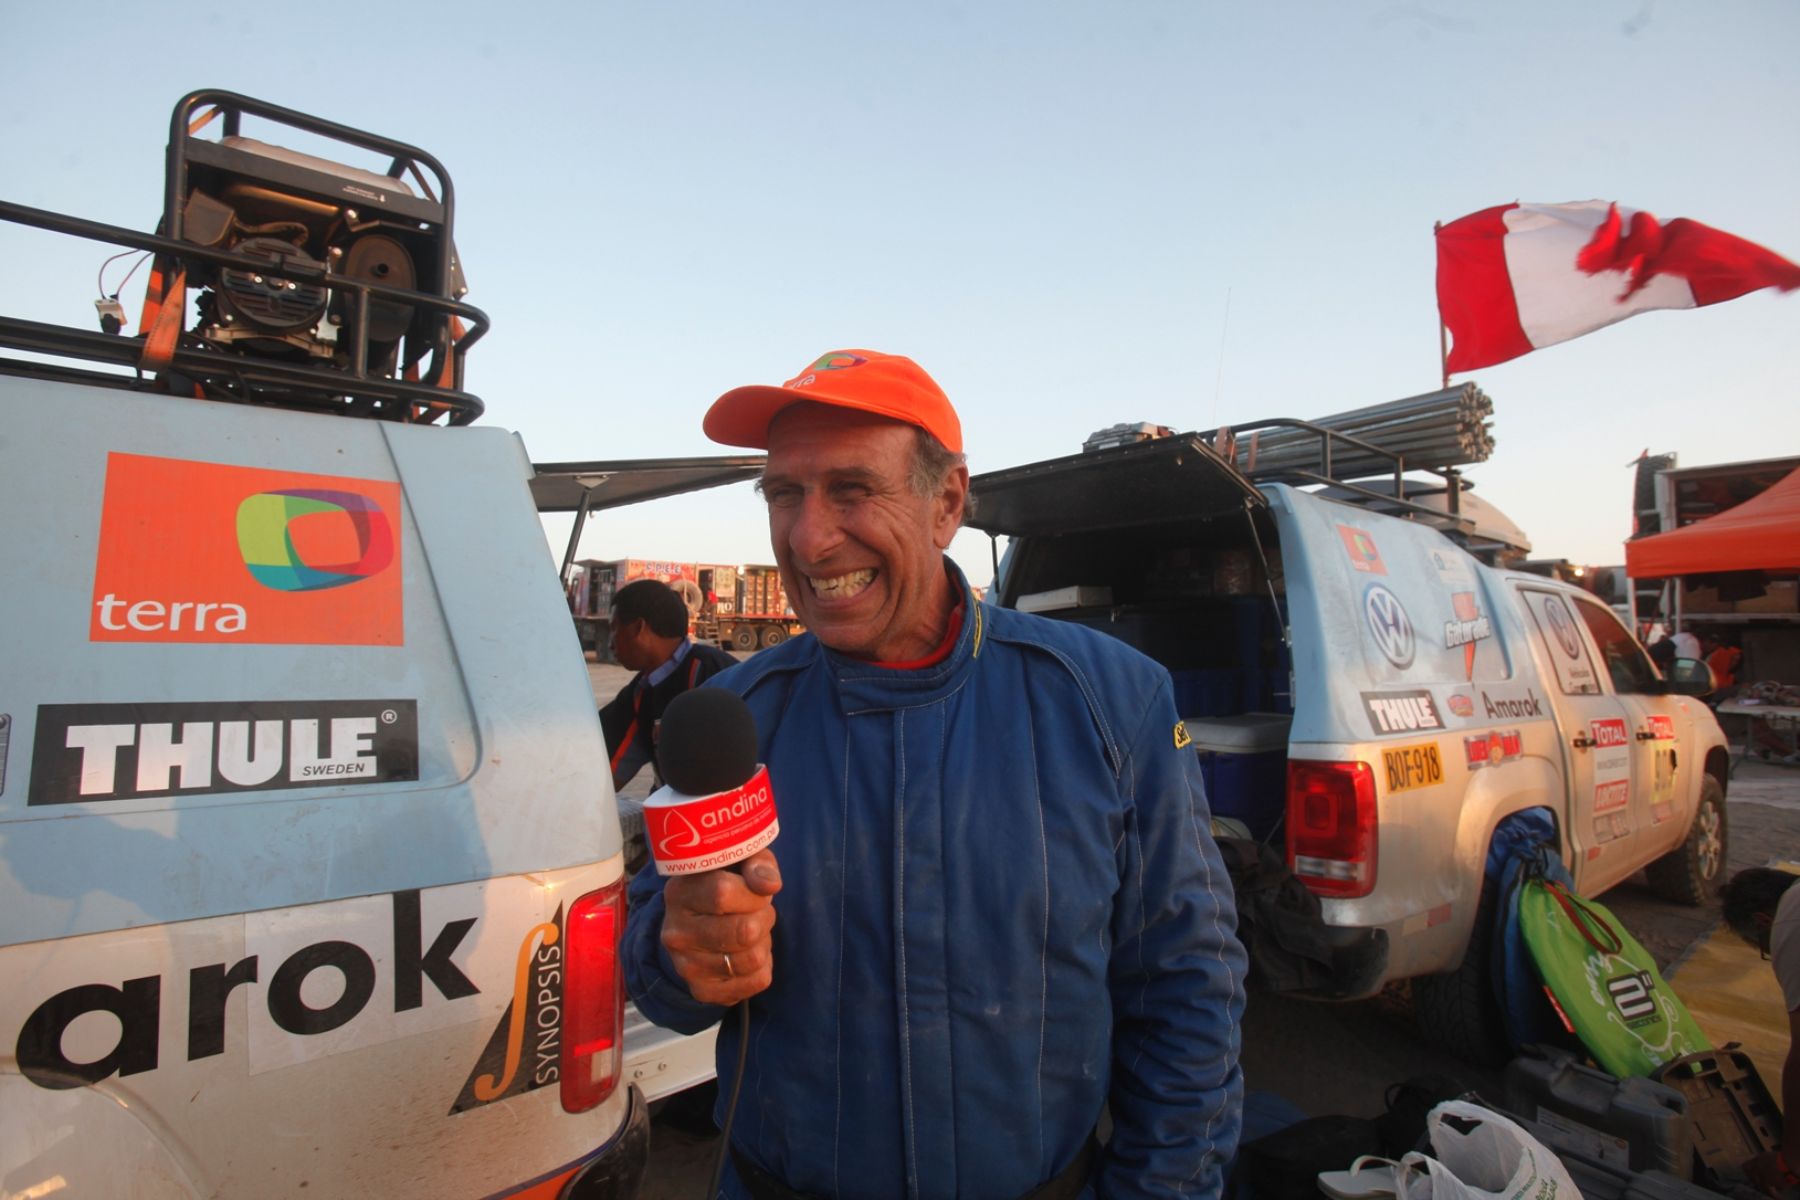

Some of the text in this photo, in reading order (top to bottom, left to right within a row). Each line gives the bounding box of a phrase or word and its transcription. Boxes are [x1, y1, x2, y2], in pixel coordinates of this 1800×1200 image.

[96, 593, 248, 633] terra
[1369, 696, 1438, 732] THULE
[1481, 688, 1542, 719] Amarok
[1592, 721, 1627, 744] TOTAL
[66, 717, 378, 796] THULE
[301, 762, 366, 778] SWEDEN
[701, 786, 768, 828] andina
[535, 944, 561, 1085] SYNOPSIS
